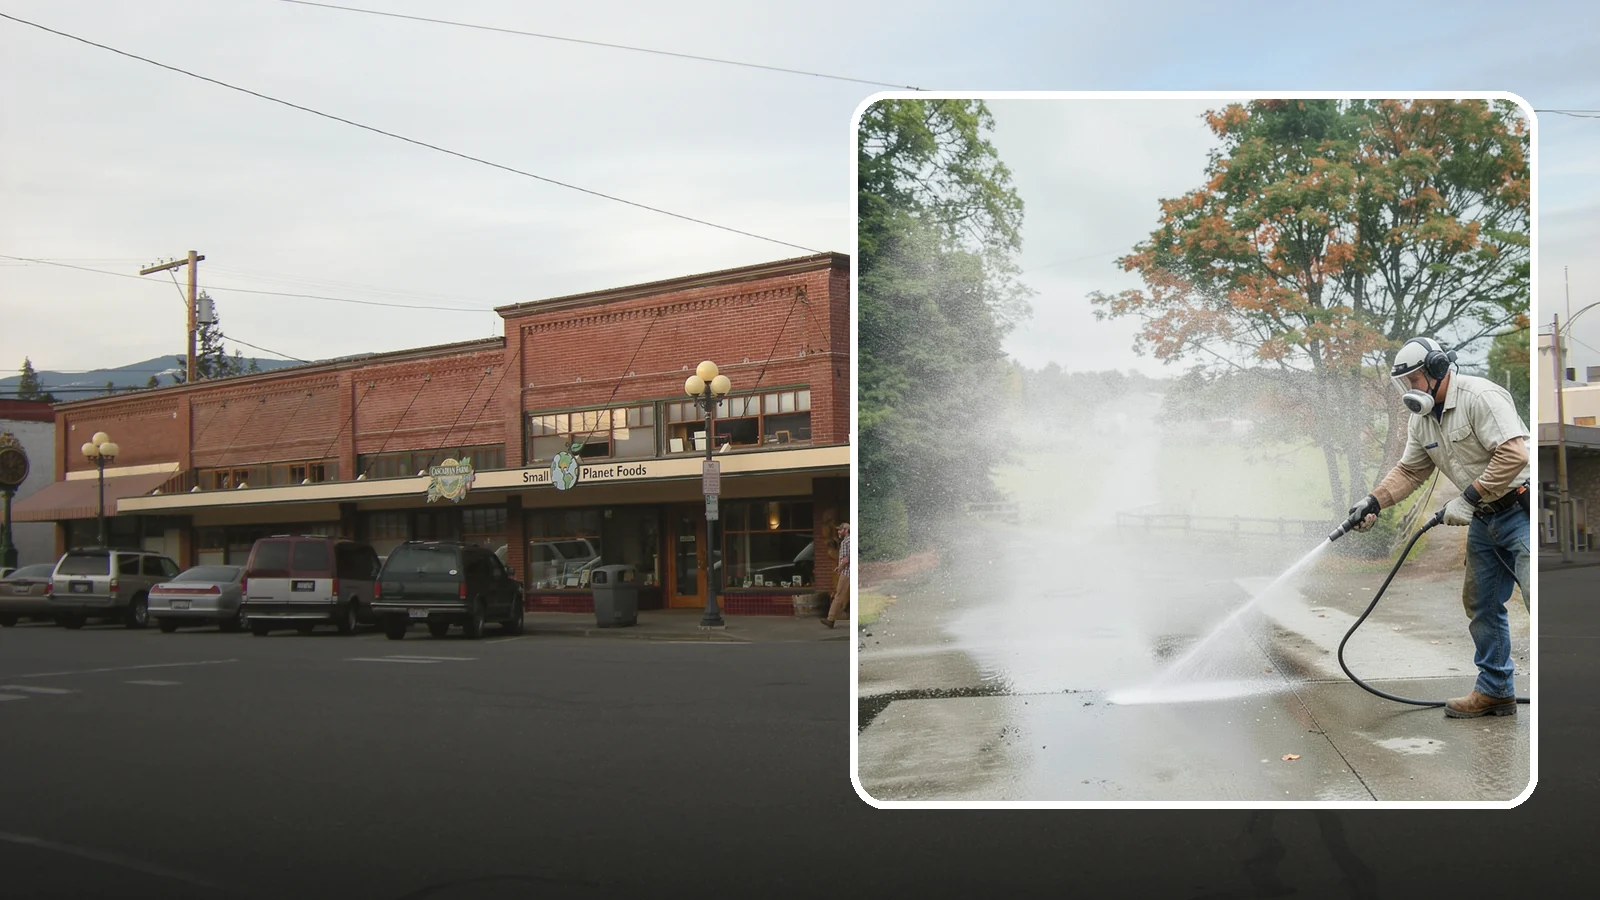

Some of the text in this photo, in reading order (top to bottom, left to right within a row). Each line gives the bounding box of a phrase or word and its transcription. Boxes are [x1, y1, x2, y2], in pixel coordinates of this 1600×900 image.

[523, 464, 647, 483] Small Planet Foods
